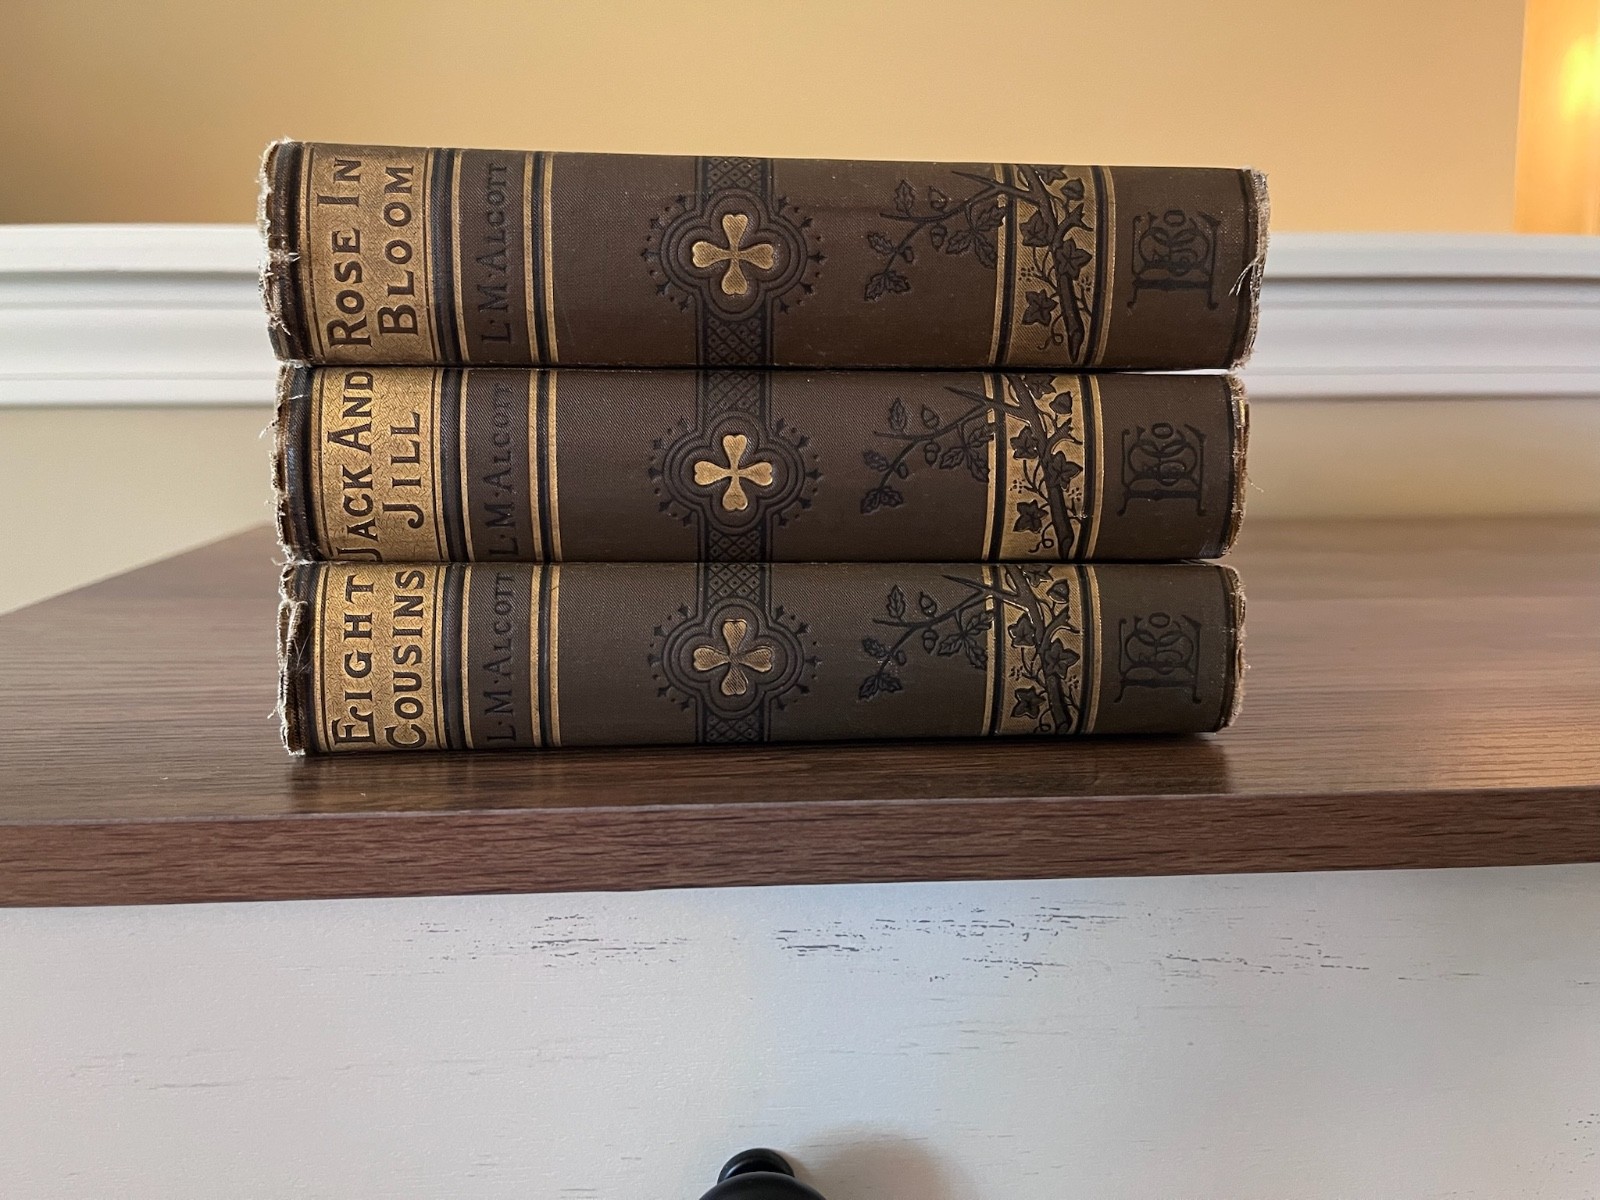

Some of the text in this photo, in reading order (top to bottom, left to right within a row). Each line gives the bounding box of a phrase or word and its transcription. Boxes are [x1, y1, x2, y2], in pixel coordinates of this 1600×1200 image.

[317, 158, 373, 348] ROSE IN
[377, 165, 419, 337] BLOOM
[327, 370, 382, 562] JACK AND
[382, 411, 424, 529] JILL
[331, 574, 377, 746] EIGHT
[385, 570, 427, 749] COUSINS
